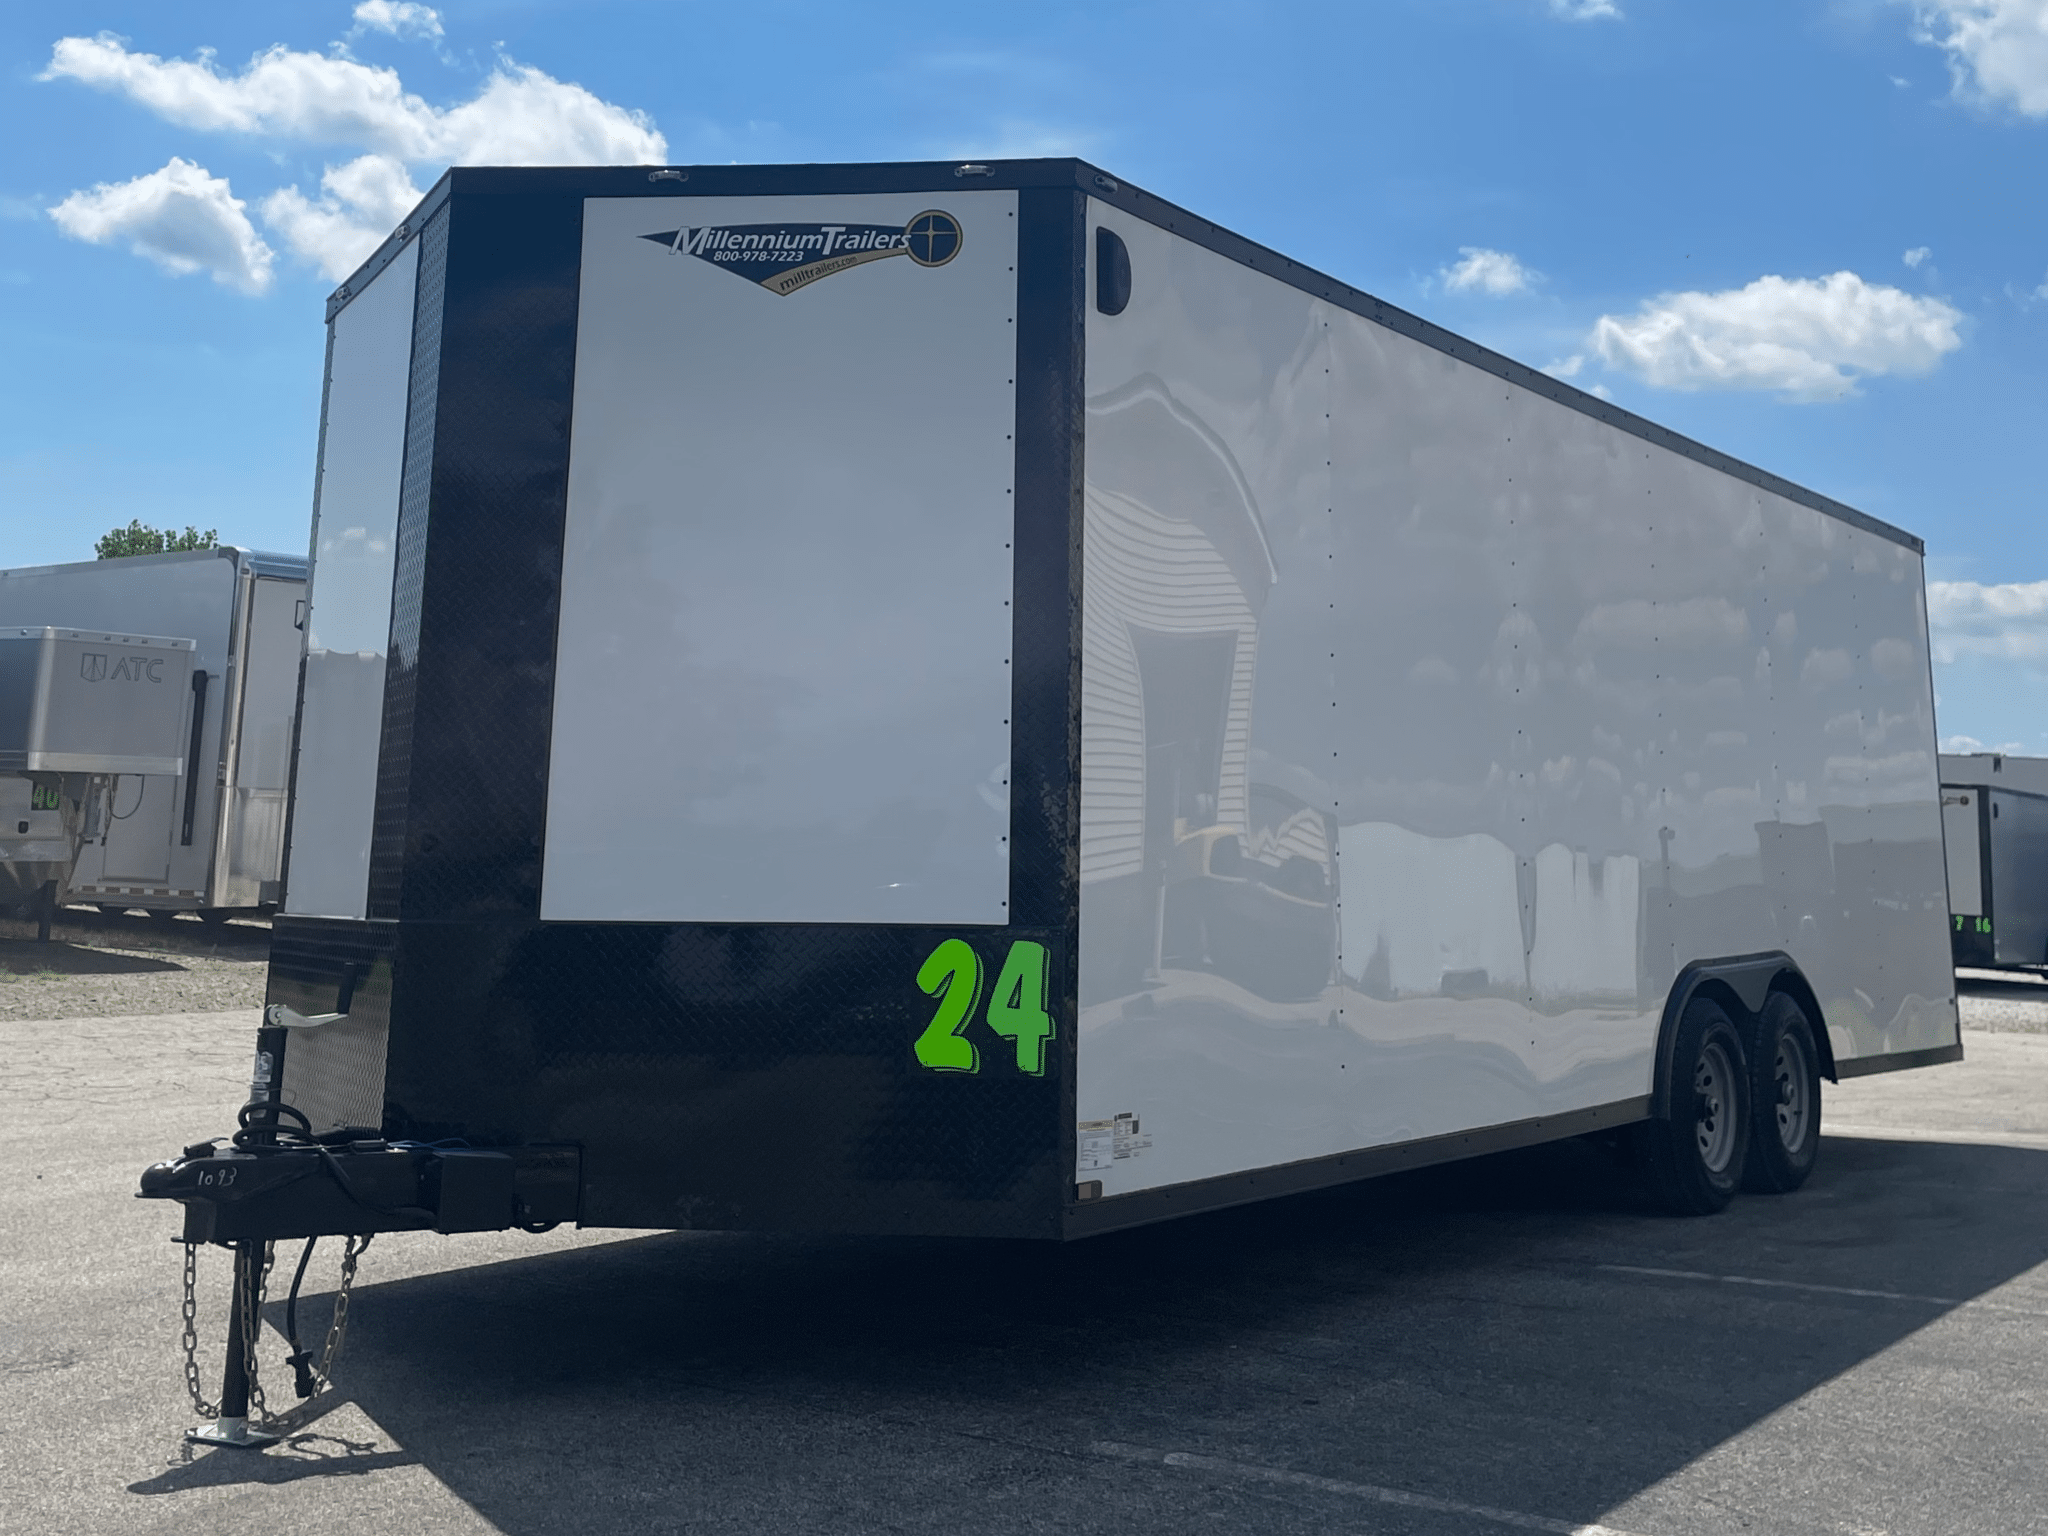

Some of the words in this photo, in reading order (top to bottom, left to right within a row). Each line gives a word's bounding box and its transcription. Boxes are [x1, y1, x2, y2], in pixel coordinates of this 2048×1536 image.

[713, 250, 804, 262] 800-978-7223
[779, 255, 858, 291] milltrailers.com
[111, 656, 164, 683] ATC
[914, 938, 1056, 1077] 24
[197, 1167, 237, 1187] 1093
